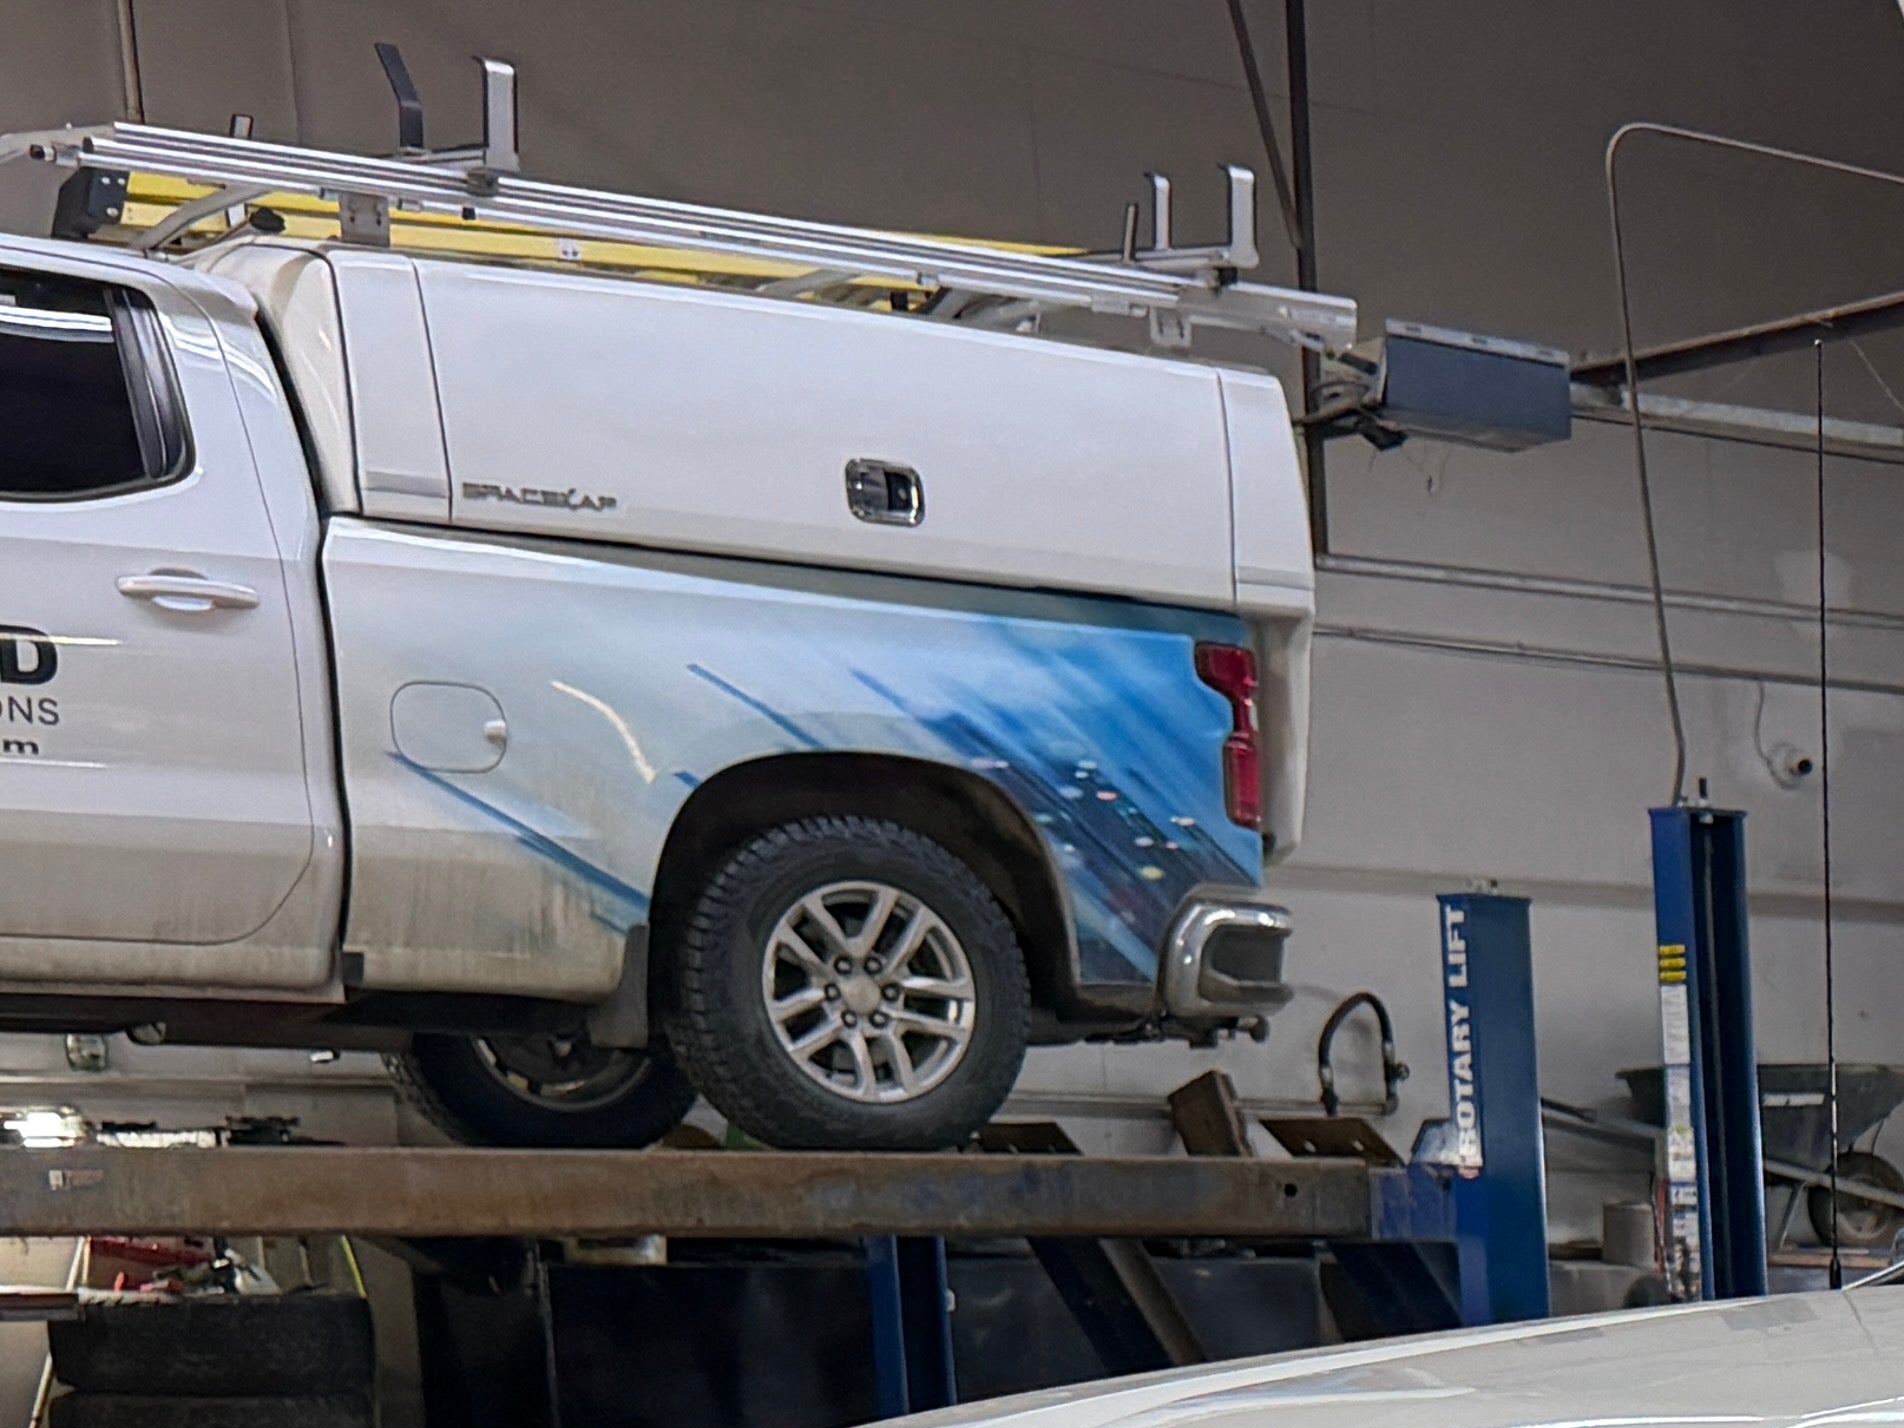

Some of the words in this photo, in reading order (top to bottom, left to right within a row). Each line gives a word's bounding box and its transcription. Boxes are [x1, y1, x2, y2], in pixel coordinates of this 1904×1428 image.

[0, 695, 60, 726] NS
[1445, 904, 1468, 988] LIFT
[1449, 999, 1478, 1158] ROTARY
